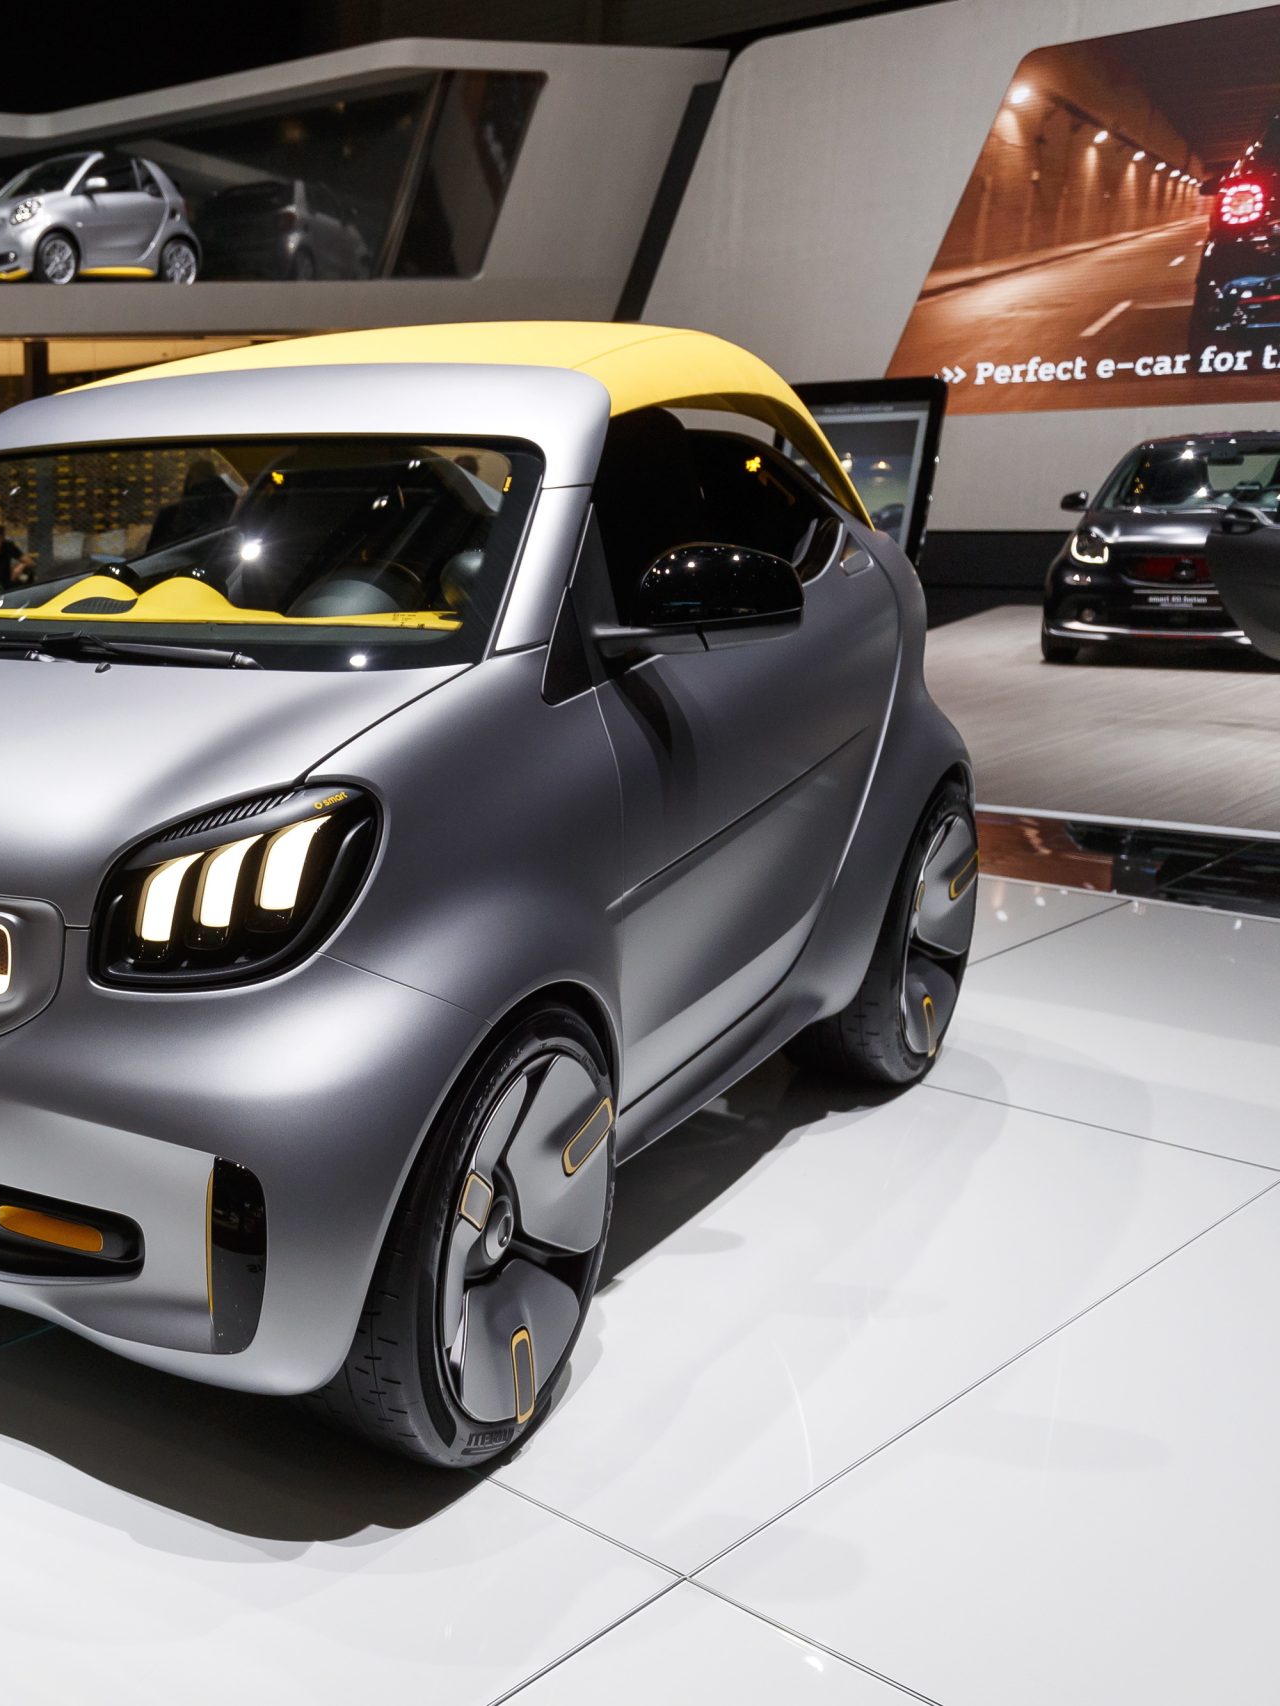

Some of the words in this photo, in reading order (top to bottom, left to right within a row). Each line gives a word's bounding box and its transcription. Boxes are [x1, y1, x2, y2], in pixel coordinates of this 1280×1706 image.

[974, 356, 1087, 385] Perfect
[1096, 353, 1190, 378] e-car
[1198, 345, 1253, 373] for
[1262, 344, 1280, 369] t
[322, 791, 348, 807] smart
